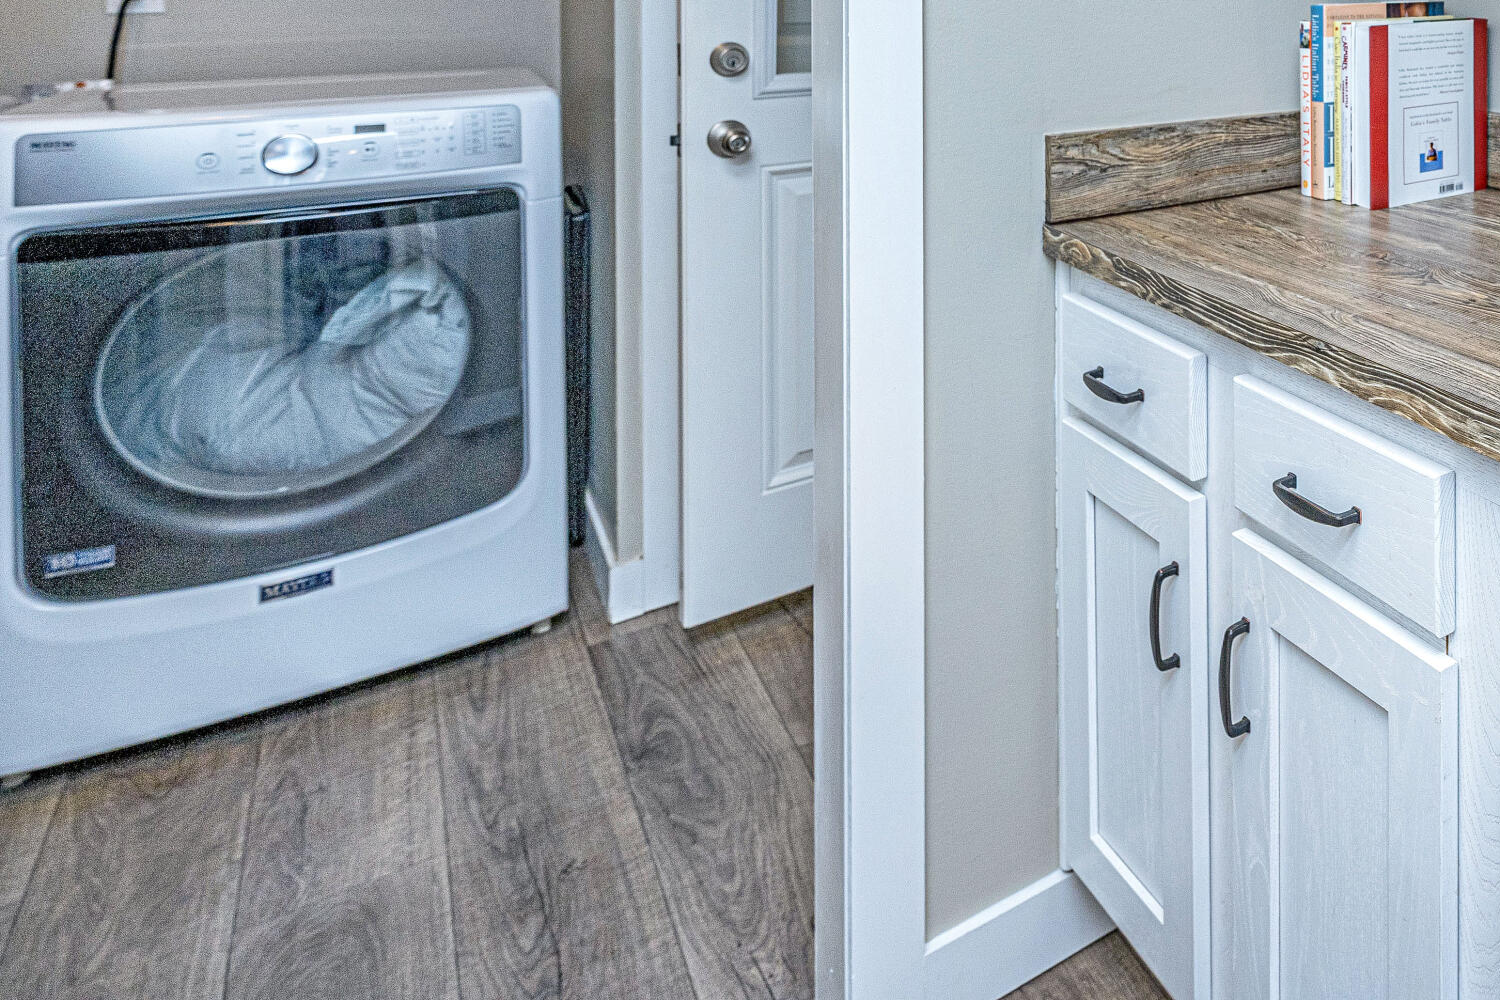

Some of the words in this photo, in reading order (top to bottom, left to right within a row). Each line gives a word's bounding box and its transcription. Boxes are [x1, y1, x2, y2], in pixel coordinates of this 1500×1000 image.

[1311, 14, 1320, 40] Lidia's
[1311, 44, 1320, 71] Italian
[1302, 55, 1310, 113] LIDIA'S
[1303, 122, 1311, 168] ITALY
